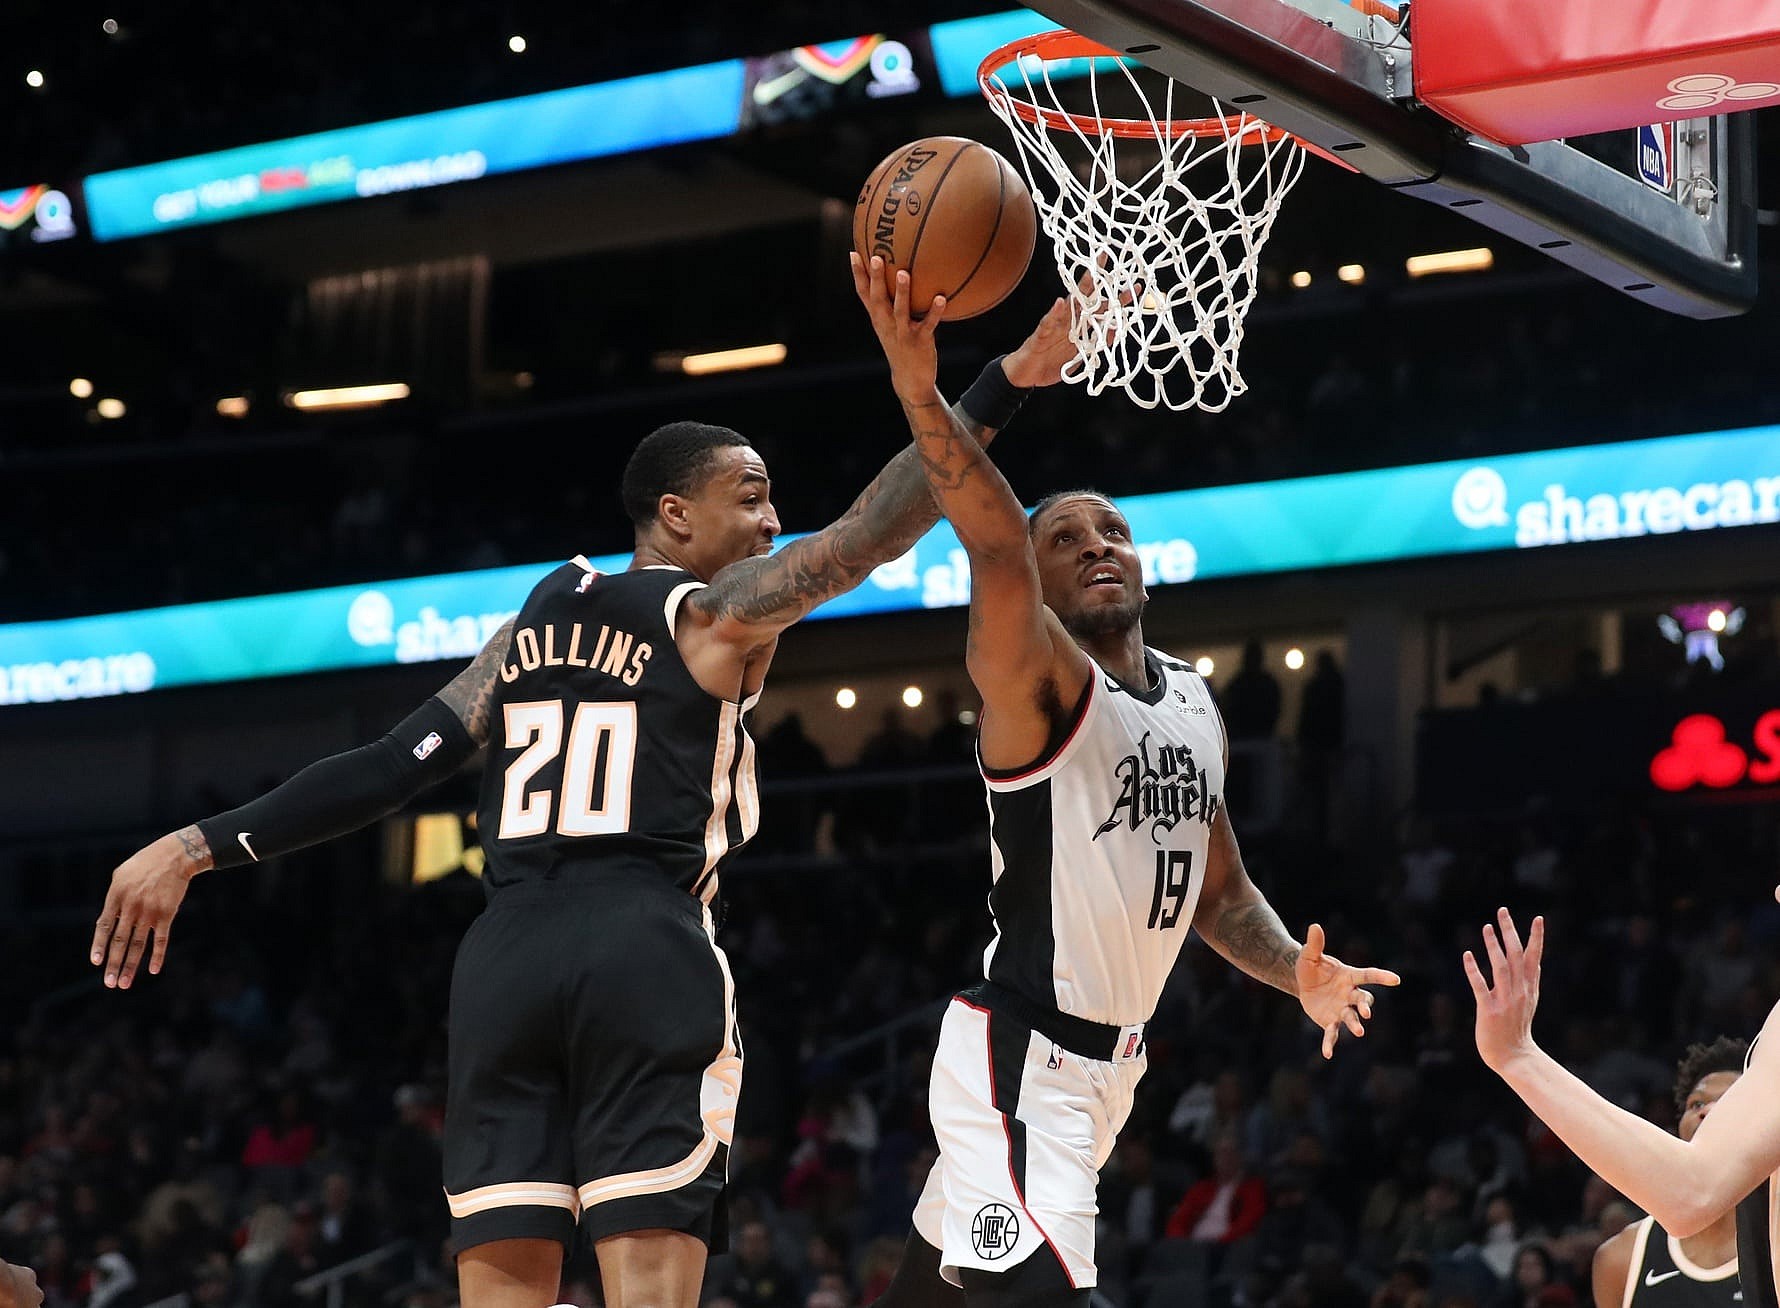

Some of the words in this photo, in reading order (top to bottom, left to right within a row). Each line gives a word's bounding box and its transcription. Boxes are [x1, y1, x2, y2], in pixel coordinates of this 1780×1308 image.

[1643, 144, 1660, 177] NBA
[872, 147, 937, 265] SPALDING
[498, 699, 637, 839] 20
[1138, 731, 1196, 783] Los
[1093, 768, 1221, 846] Angele
[1147, 850, 1192, 931] 19
